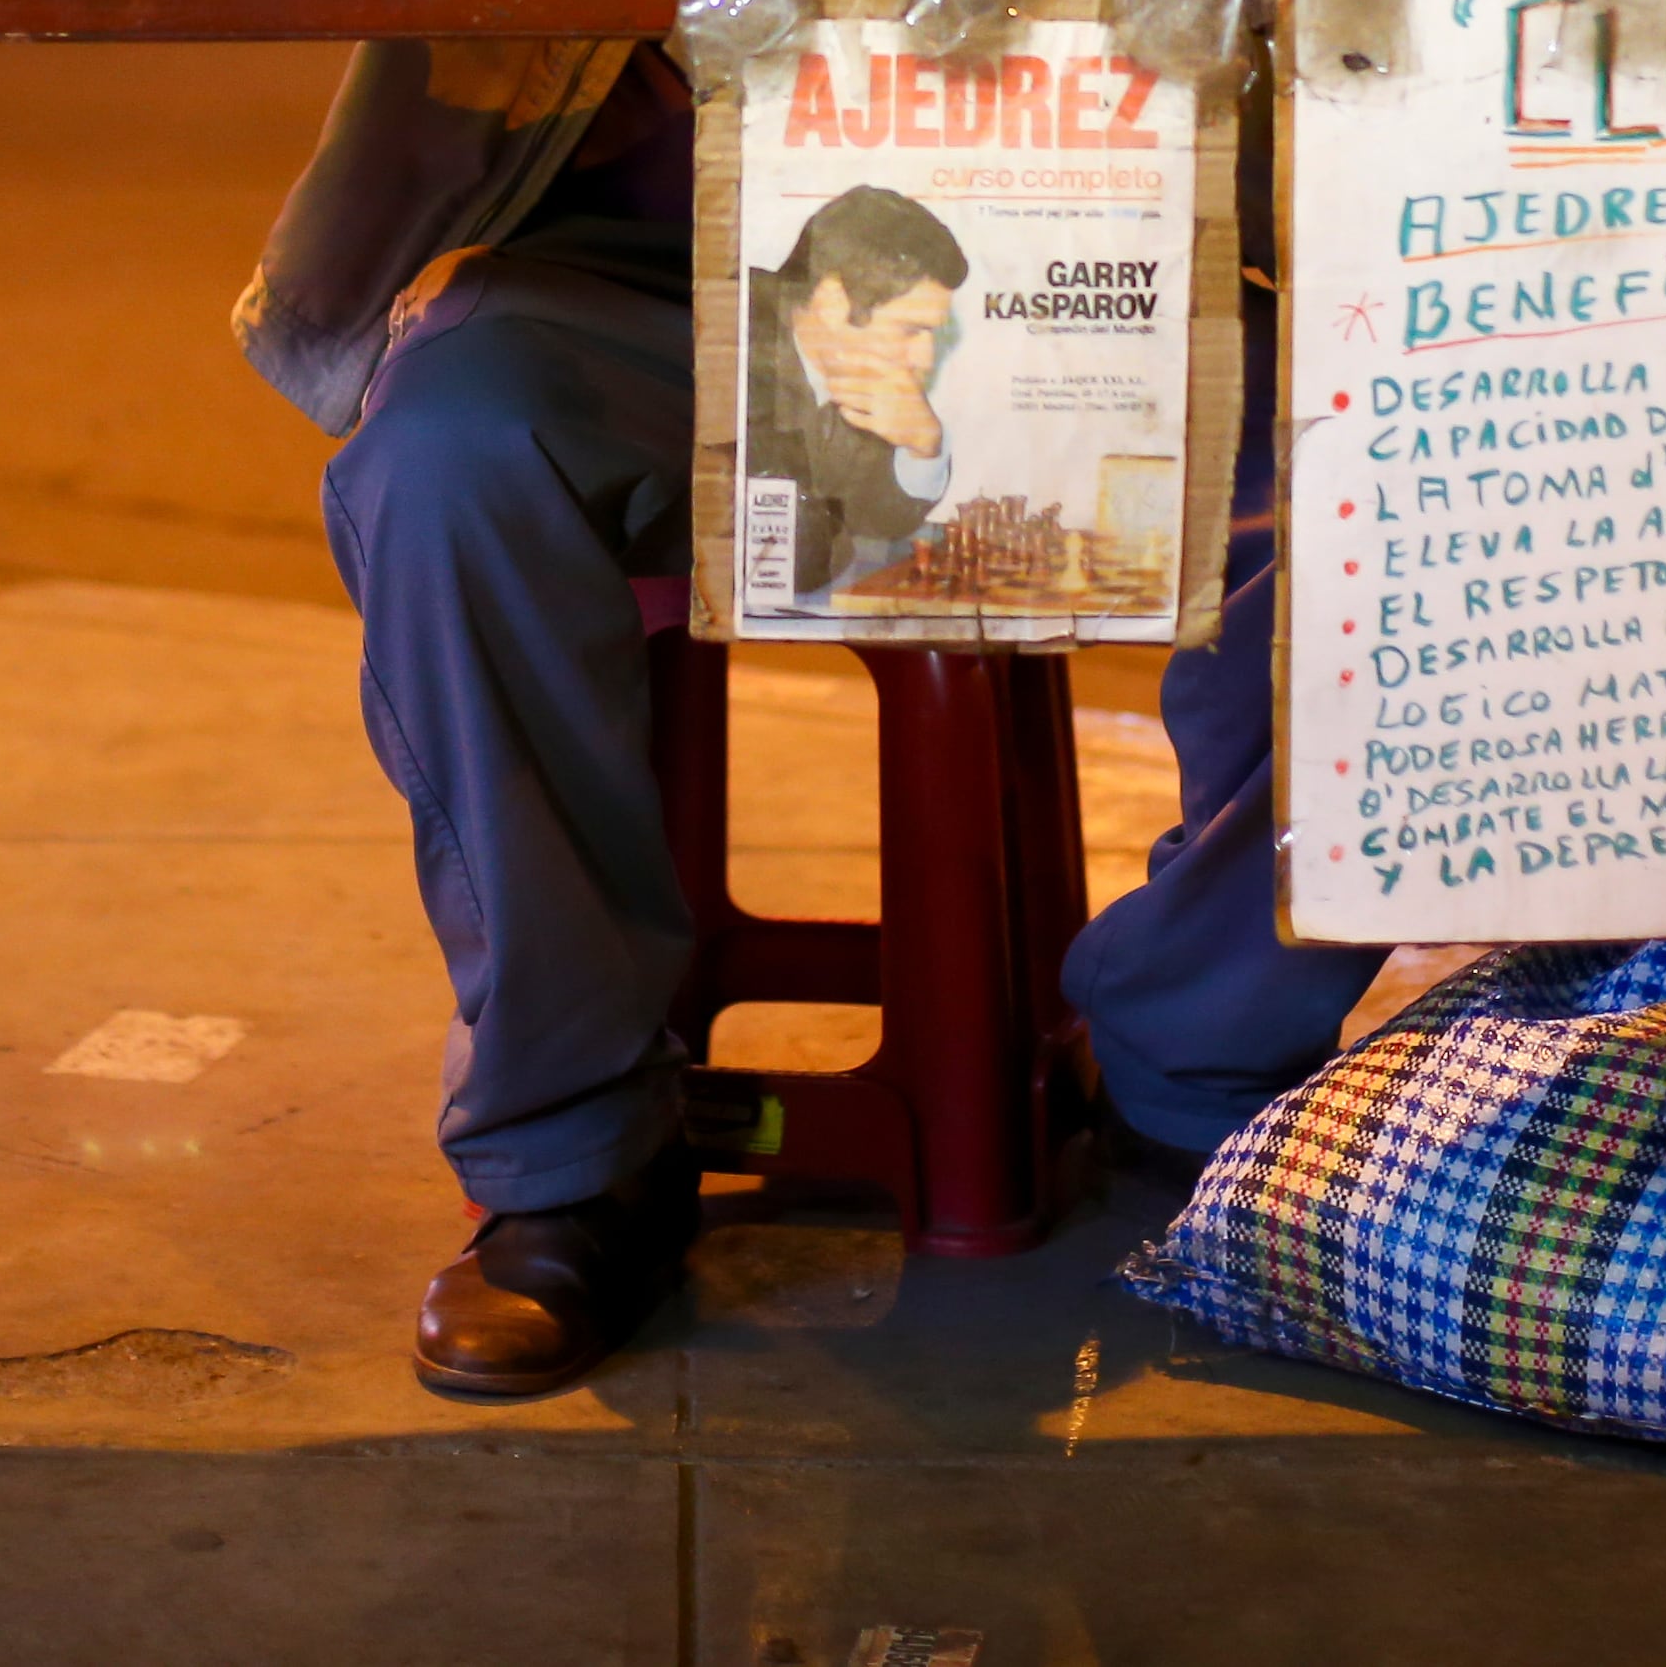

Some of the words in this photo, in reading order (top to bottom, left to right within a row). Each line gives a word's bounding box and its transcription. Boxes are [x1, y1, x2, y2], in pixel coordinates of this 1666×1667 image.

[783, 53, 1161, 149] AJEDREZ
[932, 166, 1014, 189] curso
[1021, 163, 1163, 194] completo
[1046, 260, 1160, 288] GARRY
[984, 291, 1159, 320] KASPAROV
[1371, 361, 1648, 417] DESARROLLA
[1368, 411, 1627, 463] CAPACIDAD
[1467, 465, 1607, 507] TOMA
[1384, 524, 1533, 578] ELEVA
[1565, 516, 1616, 547] LA
[1379, 590, 1435, 636] EL
[1369, 615, 1643, 688] DESARROLLA
[1365, 727, 1564, 780] PODEROSA
[1406, 762, 1631, 816] DESARROLLA
[1567, 797, 1616, 828] EL
[1373, 862, 1404, 896] Y
[1439, 846, 1497, 888] LA
